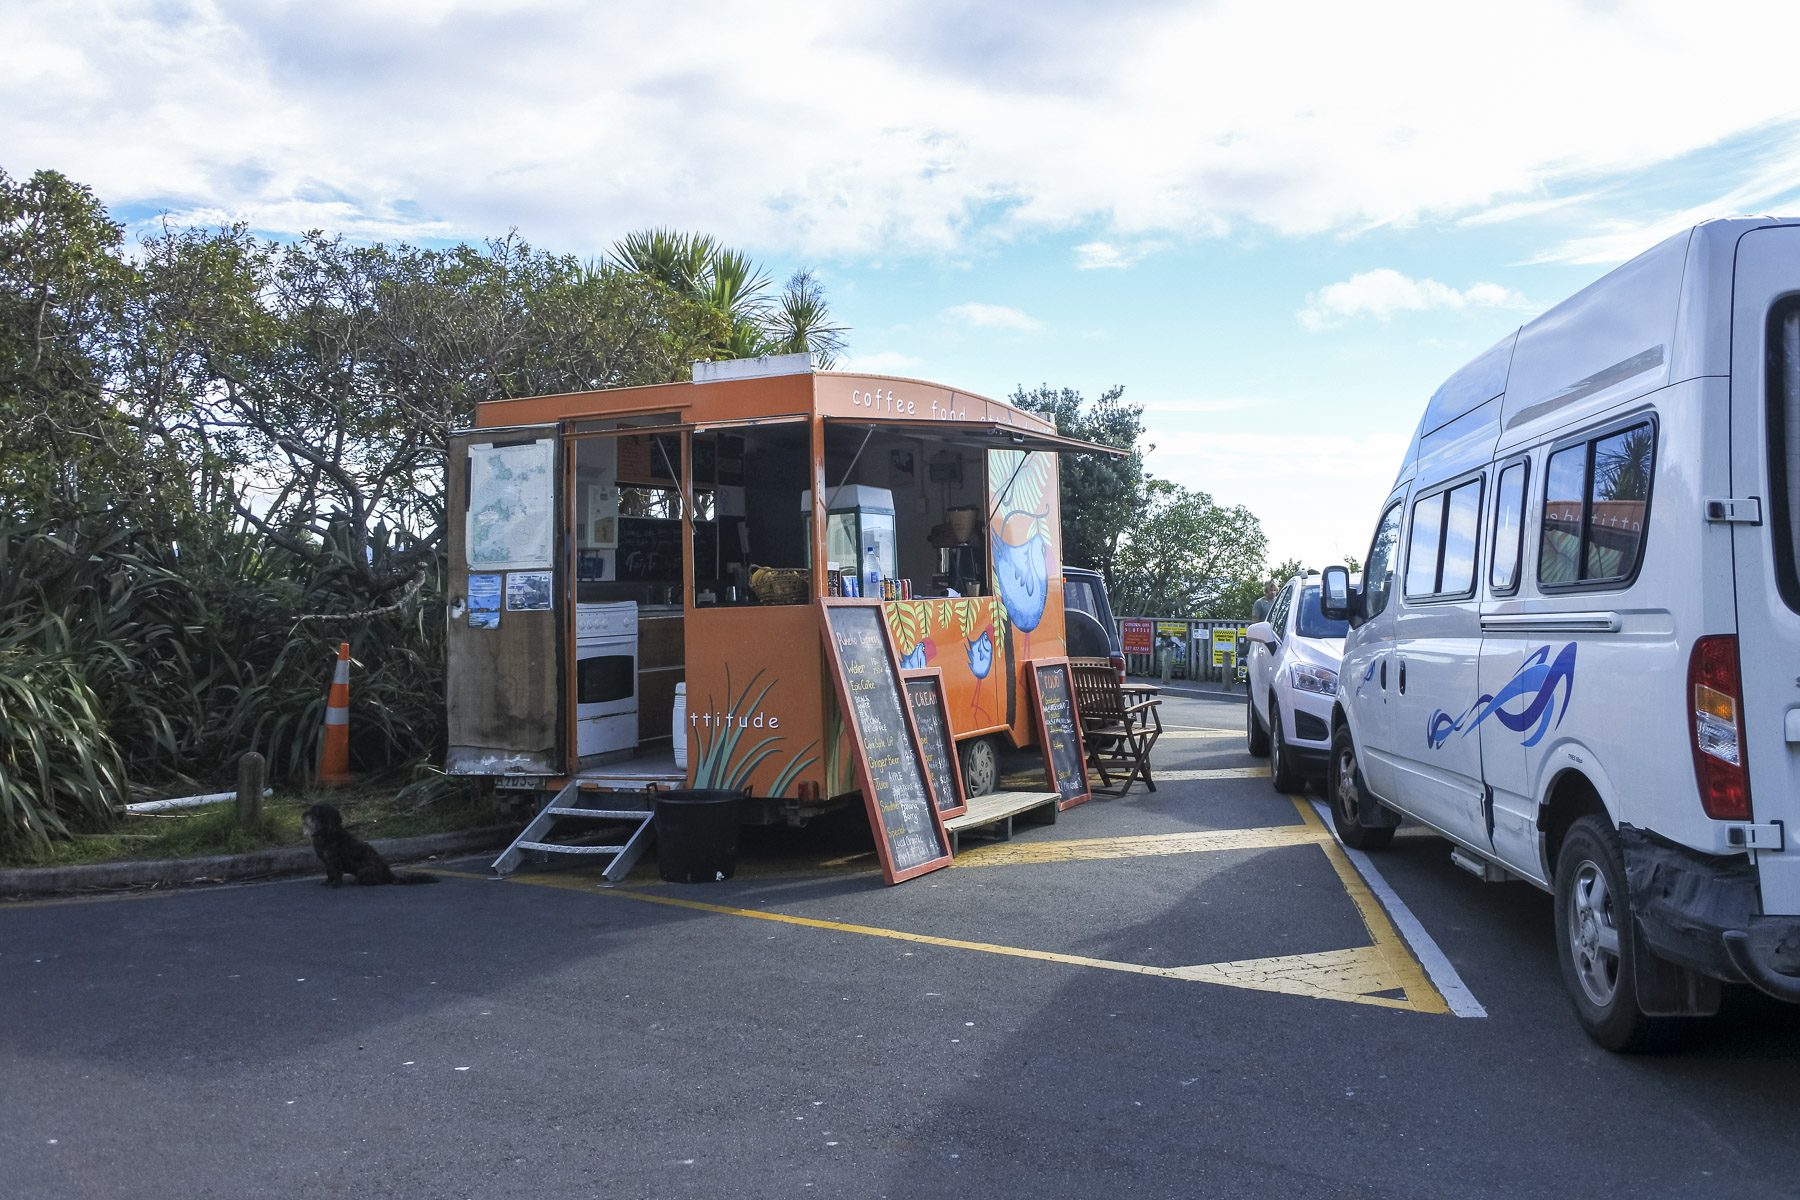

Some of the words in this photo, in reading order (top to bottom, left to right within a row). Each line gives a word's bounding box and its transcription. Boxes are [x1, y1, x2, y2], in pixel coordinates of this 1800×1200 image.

[852, 388, 916, 415] coffee
[931, 400, 966, 420] food
[844, 660, 865, 674] Water
[868, 756, 887, 774] Ginger
